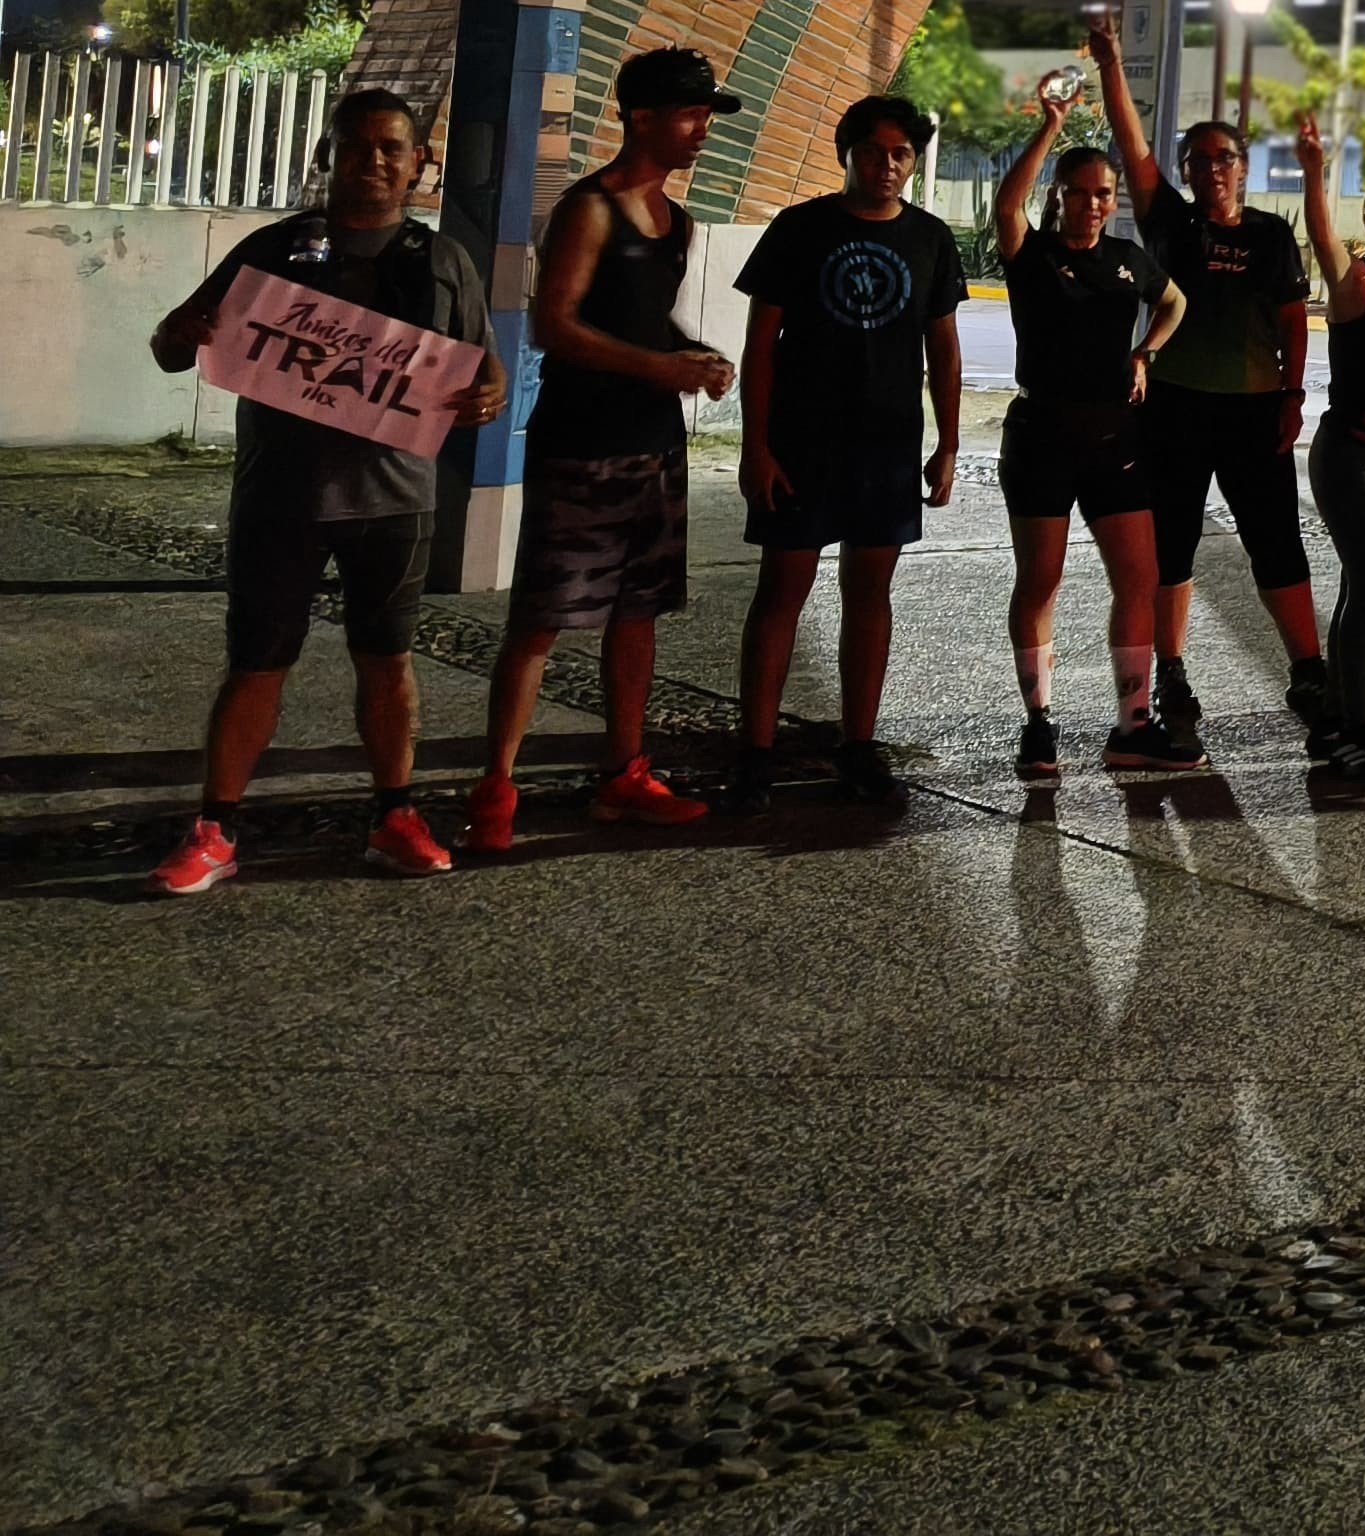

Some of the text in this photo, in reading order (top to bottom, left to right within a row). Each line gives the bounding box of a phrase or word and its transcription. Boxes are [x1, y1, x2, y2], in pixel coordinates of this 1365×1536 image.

[246, 320, 422, 416] TRAIL
[276, 302, 420, 368] Amigos del
